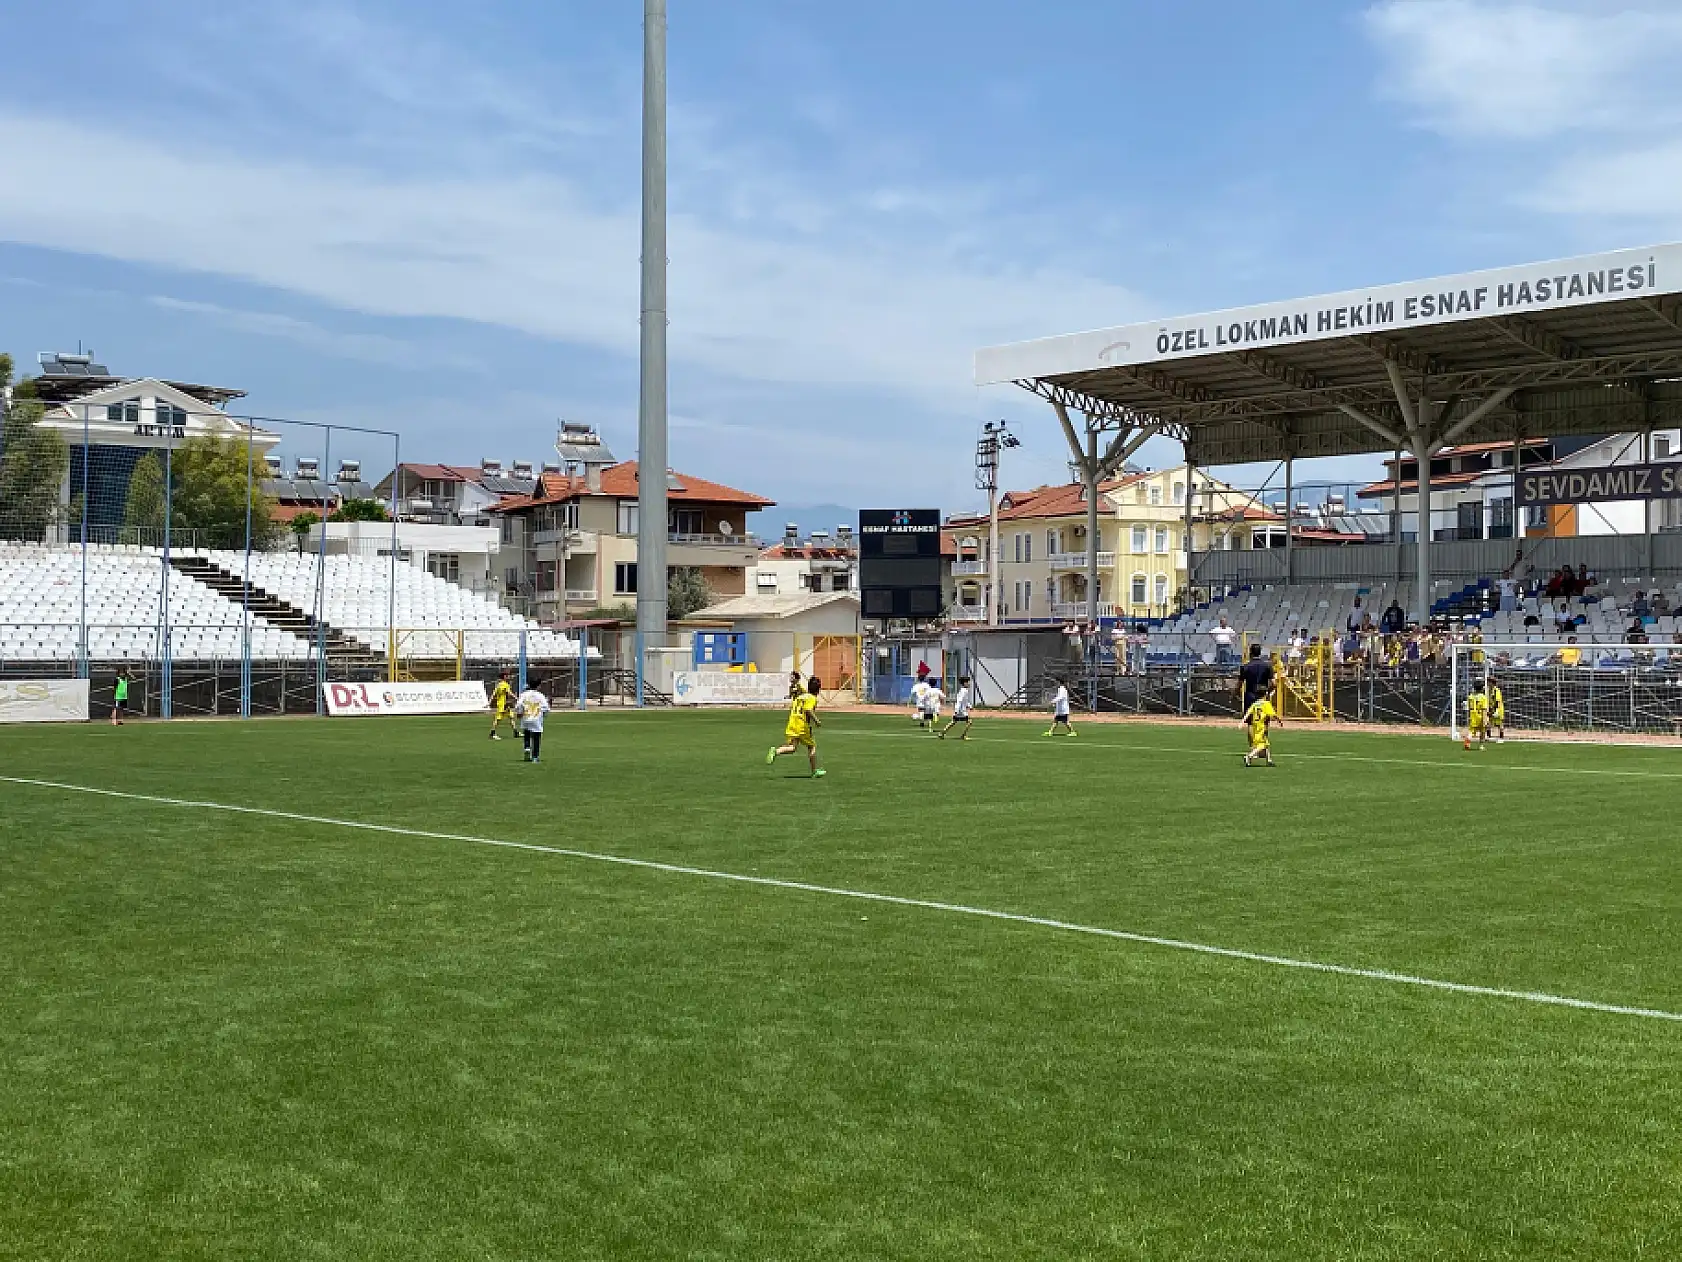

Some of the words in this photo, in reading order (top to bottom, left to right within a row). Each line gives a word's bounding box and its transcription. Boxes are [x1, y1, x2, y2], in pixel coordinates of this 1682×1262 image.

[1156, 327, 1209, 354] ÖZEL
[1216, 313, 1309, 346] LOKMAN
[1316, 297, 1394, 332] HEKİM
[1403, 287, 1488, 320] ESNAF
[1497, 257, 1656, 307] HASTANESİ
[1524, 469, 1652, 501] SEVDAMIZ
